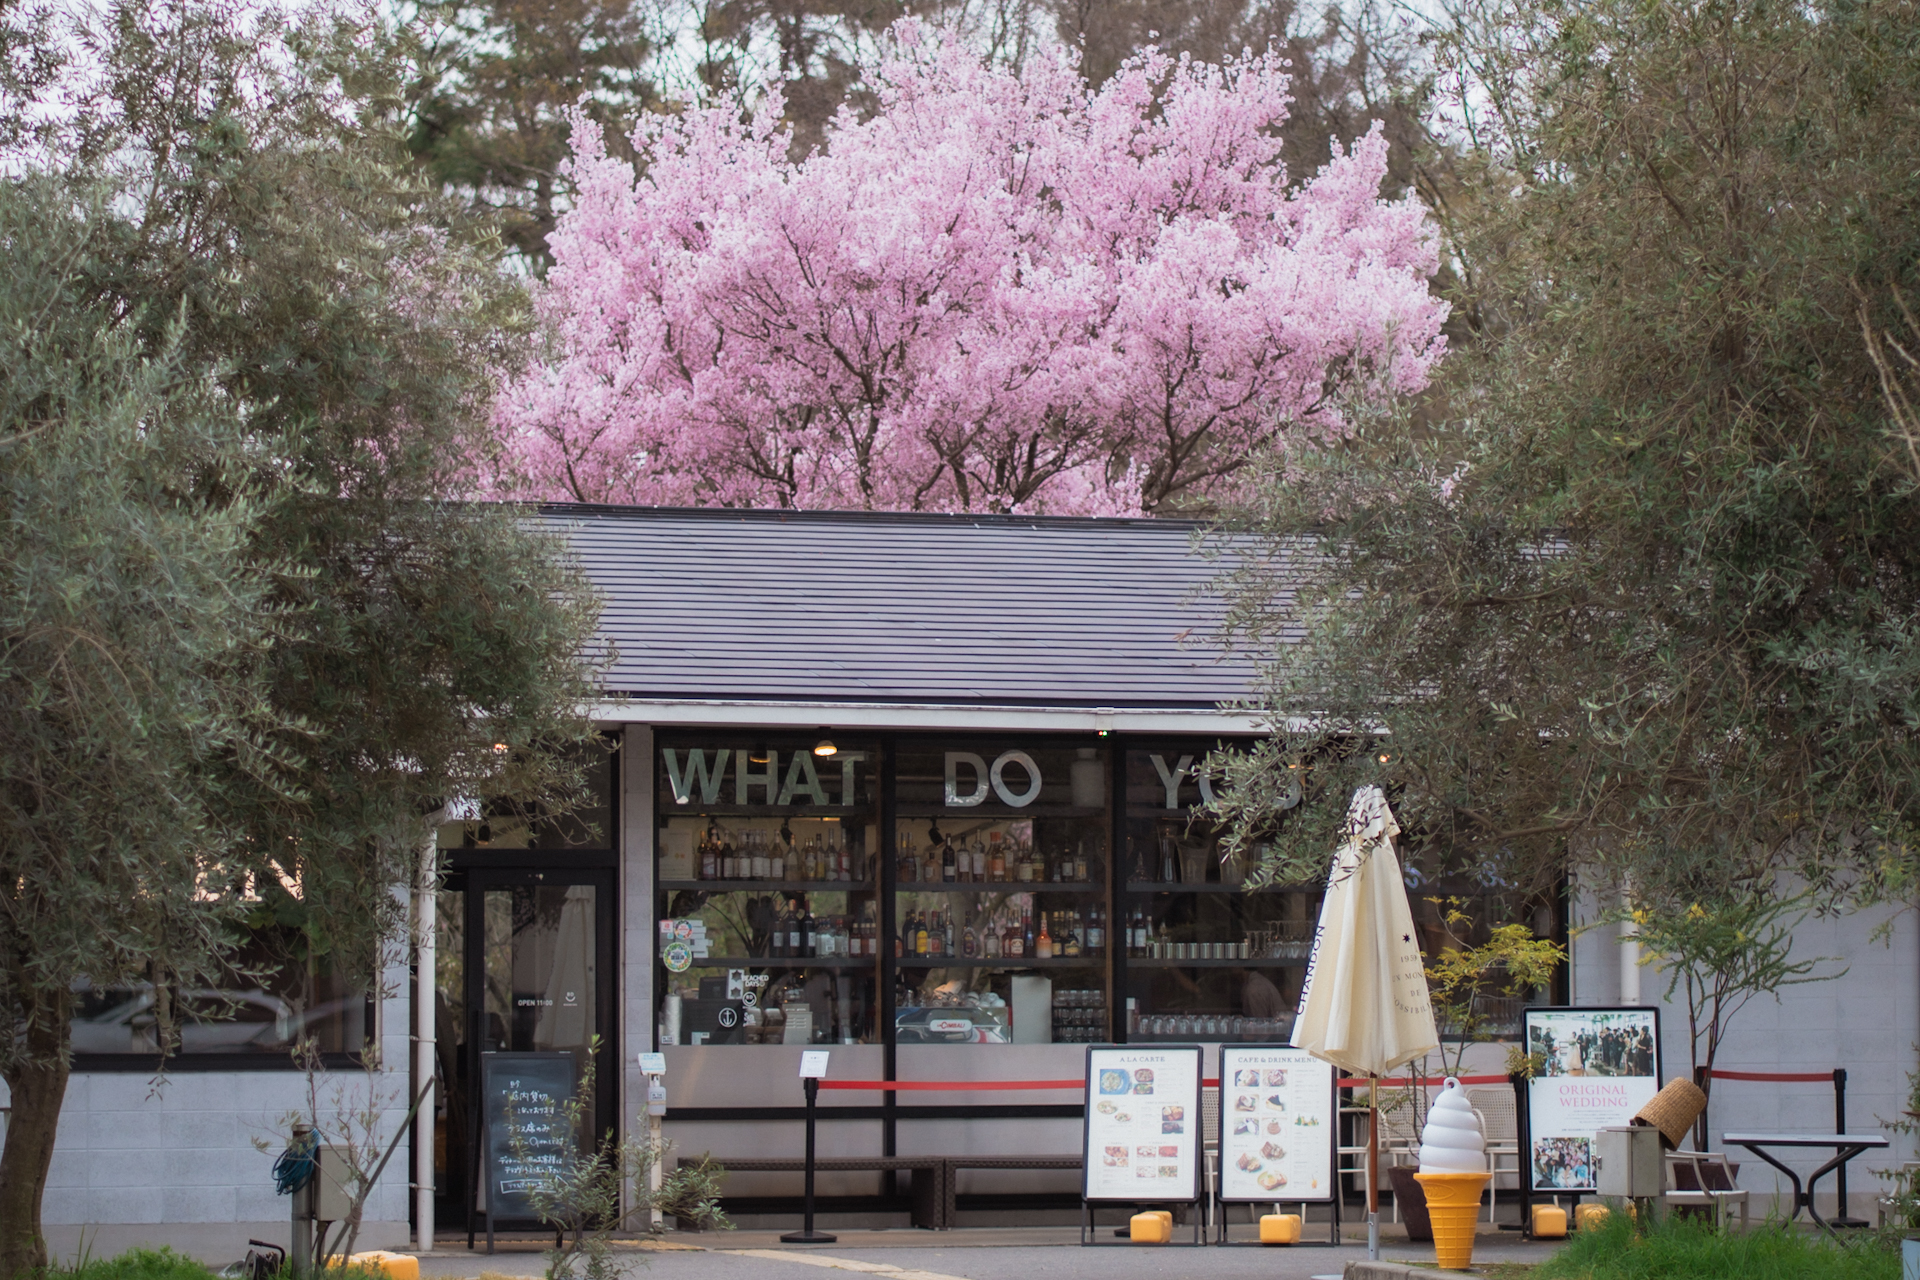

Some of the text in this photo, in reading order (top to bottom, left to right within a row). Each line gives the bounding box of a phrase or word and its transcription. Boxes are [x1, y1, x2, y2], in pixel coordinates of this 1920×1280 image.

[662, 748, 867, 806] WHAT
[944, 749, 1042, 808] DO
[1297, 925, 1325, 1015] CHANDON
[517, 999, 536, 1007] OPEN
[1559, 1084, 1628, 1096] ORIGINAL
[1560, 1097, 1628, 1108] WEDDING
